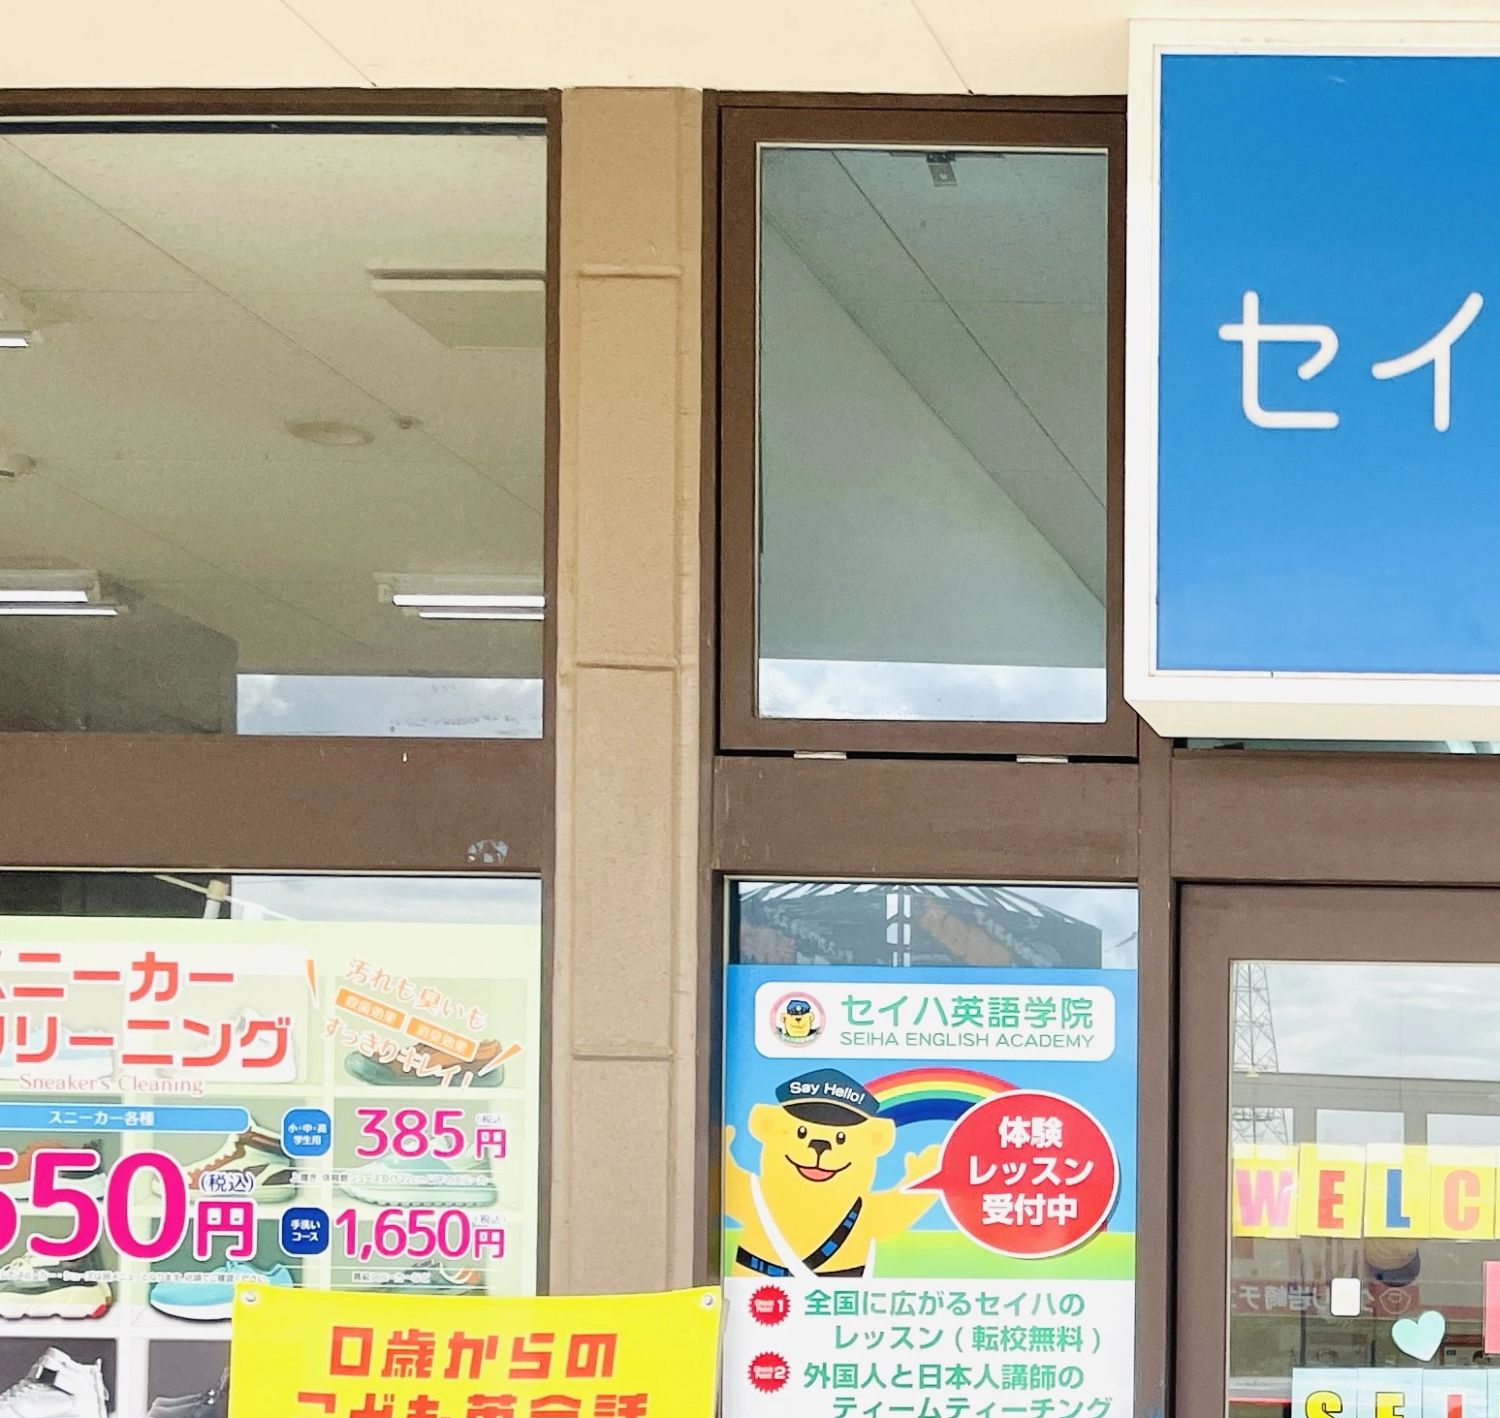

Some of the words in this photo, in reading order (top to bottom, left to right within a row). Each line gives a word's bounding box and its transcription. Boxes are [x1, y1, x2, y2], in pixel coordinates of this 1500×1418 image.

[0, 951, 234, 1002] ニーカー
[840, 995, 1093, 1030] セイハ英語学院
[840, 1032, 898, 1046] SEIHA
[906, 1032, 989, 1048] ENGLISH
[995, 1033, 1095, 1049] ACADEMY
[118, 1076, 203, 1094] Cleaning
[789, 1081, 821, 1097] Say
[823, 1083, 865, 1105] Hello!
[49, 1110, 155, 1127] スニーカー各種
[355, 1109, 507, 1160] 385円
[998, 1116, 1064, 1149] 体験
[969, 1159, 1094, 1186] レッスン
[0, 1152, 254, 1259] 50円
[981, 1192, 1078, 1227] 受付中
[291, 1232, 320, 1242] コース
[335, 1208, 506, 1260] 1,650円
[804, 1290, 1085, 1317] 全国に広がるセイハの
[804, 1363, 1084, 1390] 外国人と日本人講師の
